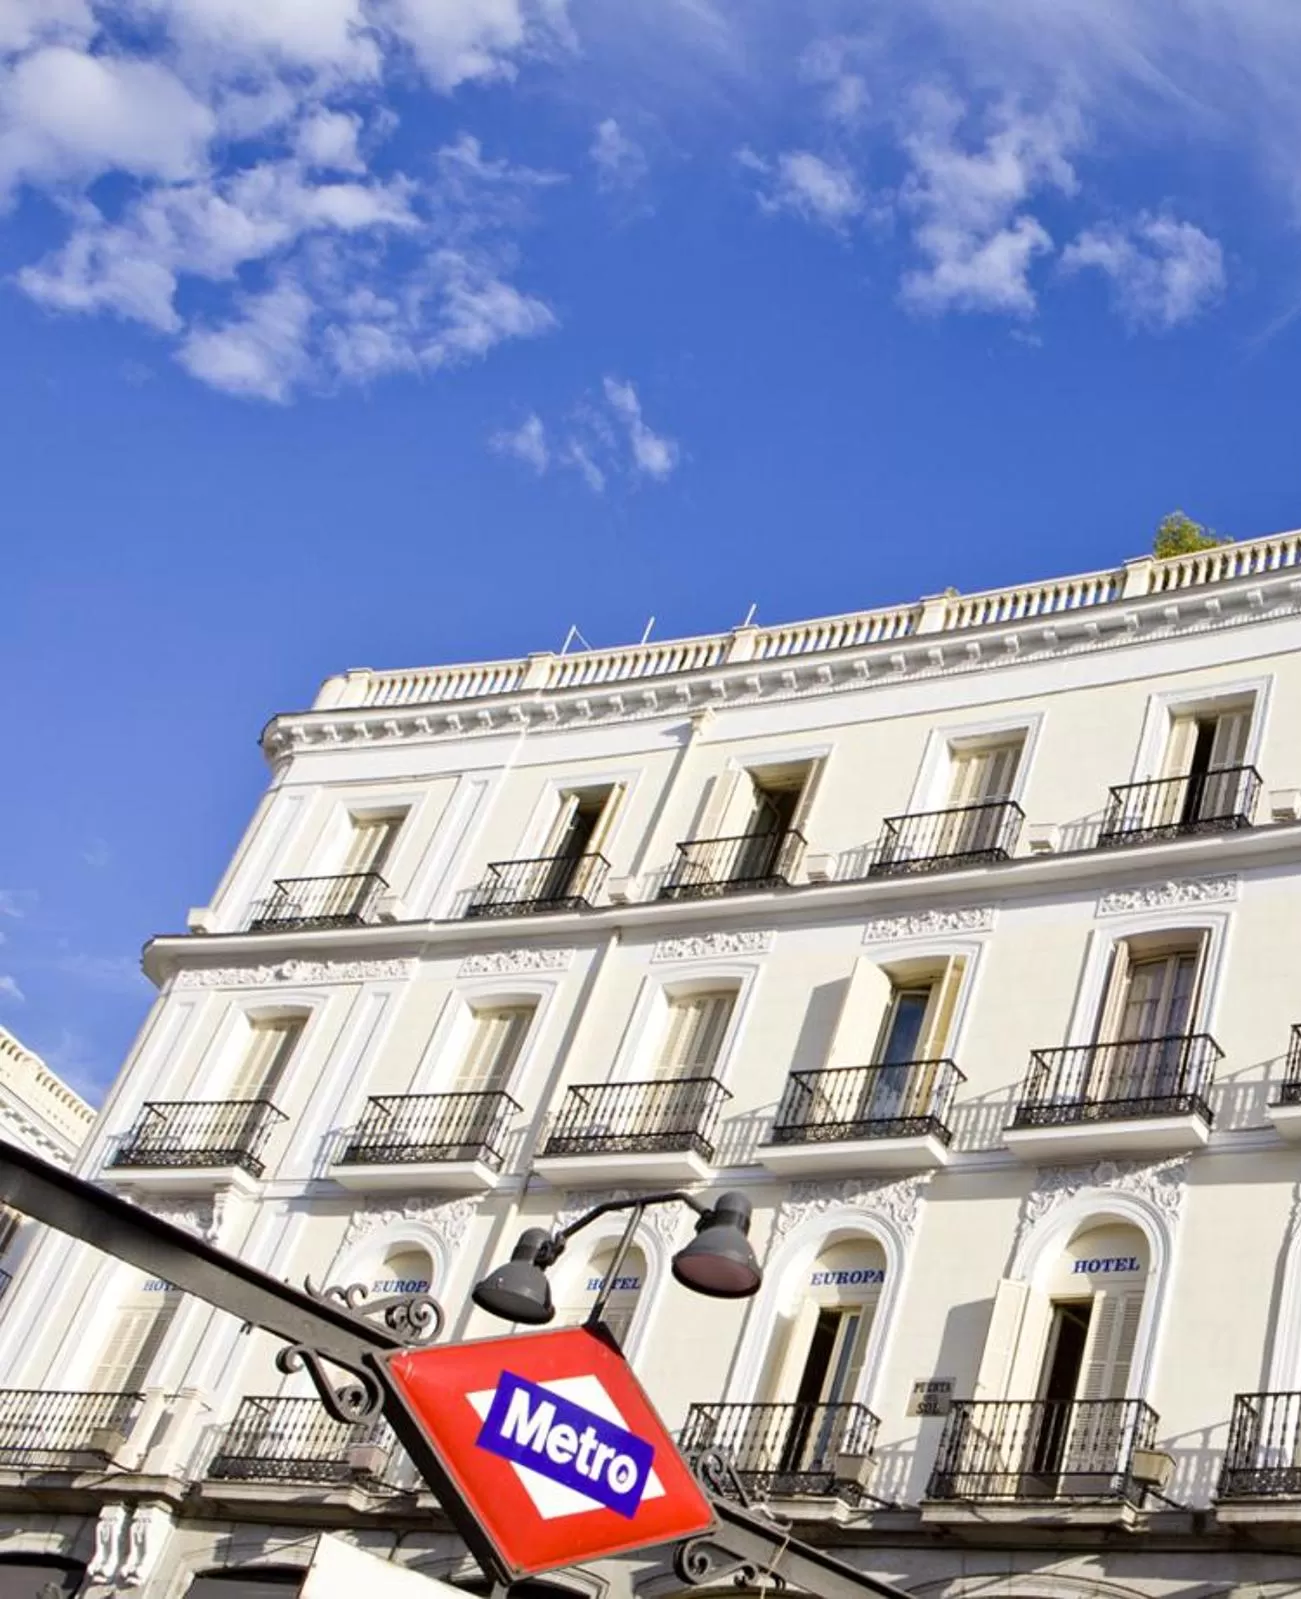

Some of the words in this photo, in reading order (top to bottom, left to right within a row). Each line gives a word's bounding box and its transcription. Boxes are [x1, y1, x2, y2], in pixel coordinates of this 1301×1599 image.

[1073, 1257, 1140, 1273] HOTEL
[811, 1270, 885, 1285] EUROPA
[500, 1387, 638, 1494] Metro
